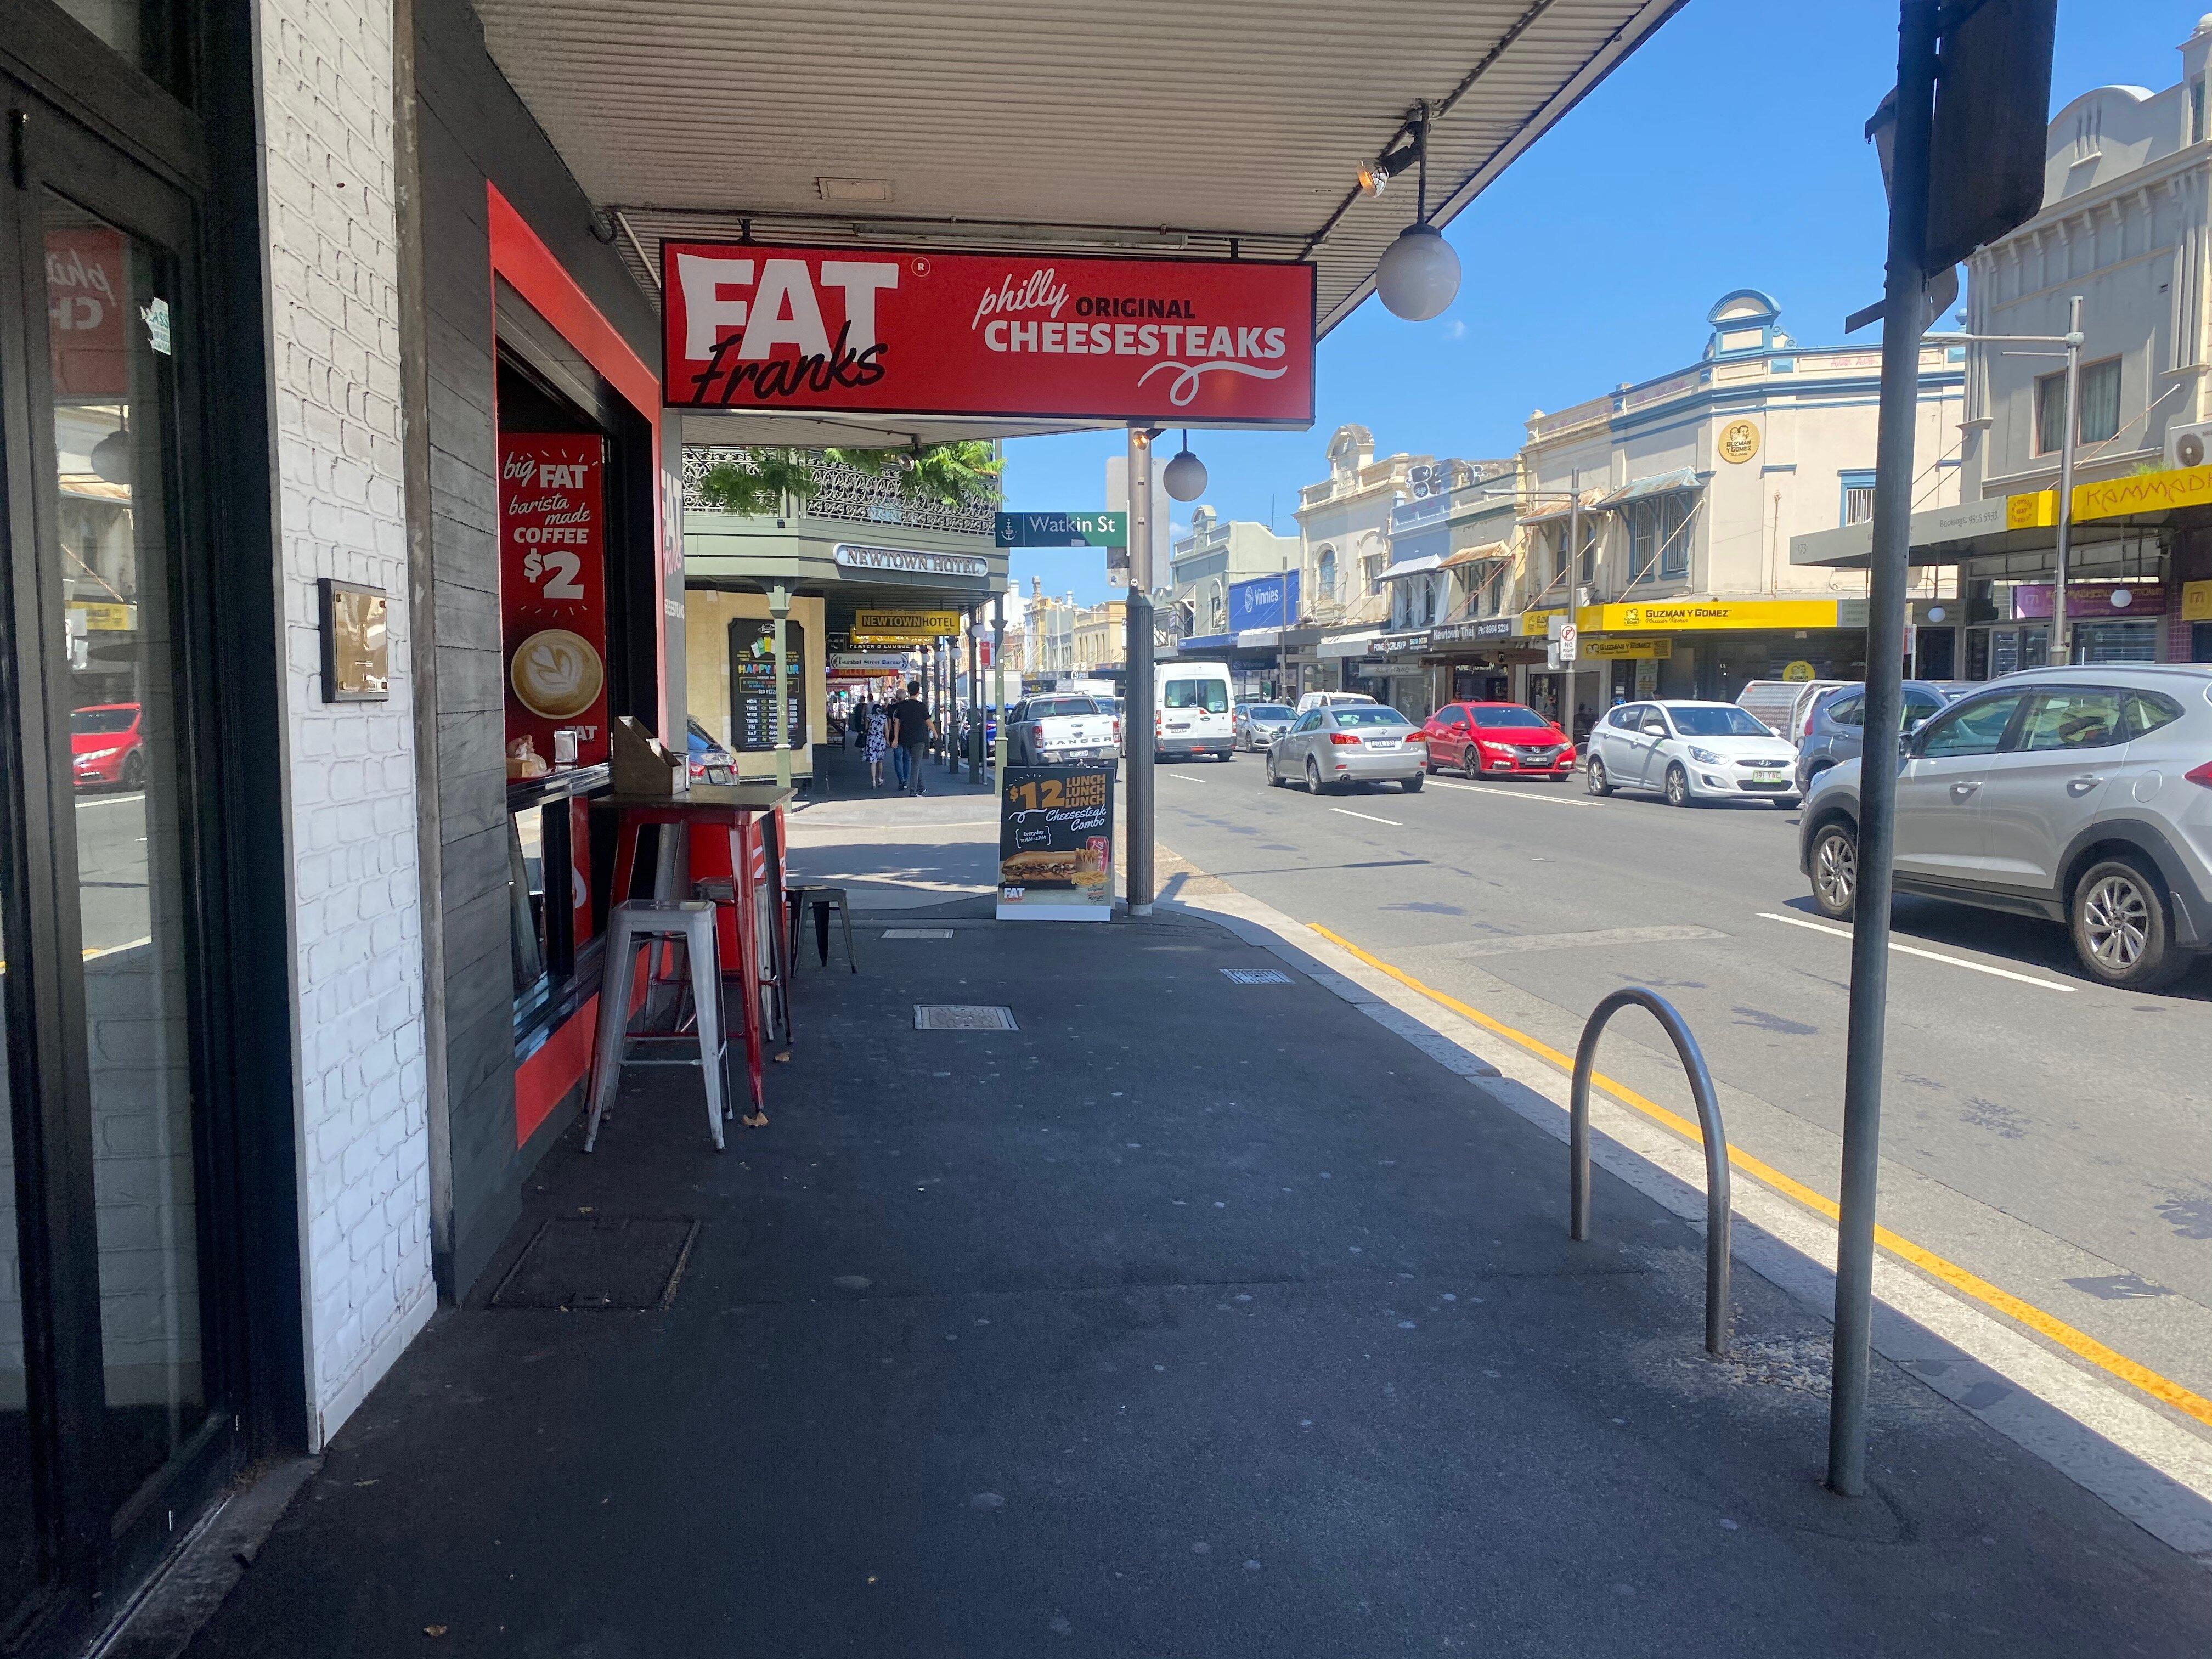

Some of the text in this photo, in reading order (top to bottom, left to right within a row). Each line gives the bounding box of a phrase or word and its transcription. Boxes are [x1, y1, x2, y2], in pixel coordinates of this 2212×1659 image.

[676, 253, 899, 362] FAT
[972, 268, 1195, 330] philly ORIGINAL
[984, 320, 1286, 359] CHEESESTEAKS
[691, 320, 888, 404] Franks
[503, 451, 588, 489] big FAT
[509, 492, 569, 515] barista
[544, 502, 591, 526] made
[1029, 516, 1115, 533] Watkin St
[514, 527, 589, 544] COFFEE
[847, 548, 980, 574] NEWTOWN HOTEL
[523, 548, 584, 599] $2
[1254, 586, 1279, 606] Vinnies
[863, 616, 955, 627] NEWTOWN HOTEL
[1646, 610, 1685, 618] GUZMAN
[1695, 609, 1729, 617] GOMEZ
[1433, 629, 1459, 641] Newtown
[1460, 626, 1474, 637] Thai
[738, 664, 771, 675] HAPPY
[565, 725, 598, 741] AT
[1045, 737, 1111, 746] RANGER
[1009, 774, 1106, 810] $12 LUNCH
[1065, 784, 1105, 798] LUNCH
[1065, 794, 1105, 808] LUNCH
[1046, 803, 1107, 823] Cheesesteak
[1070, 816, 1105, 832] Combo
[1003, 887, 1025, 898] FAT
